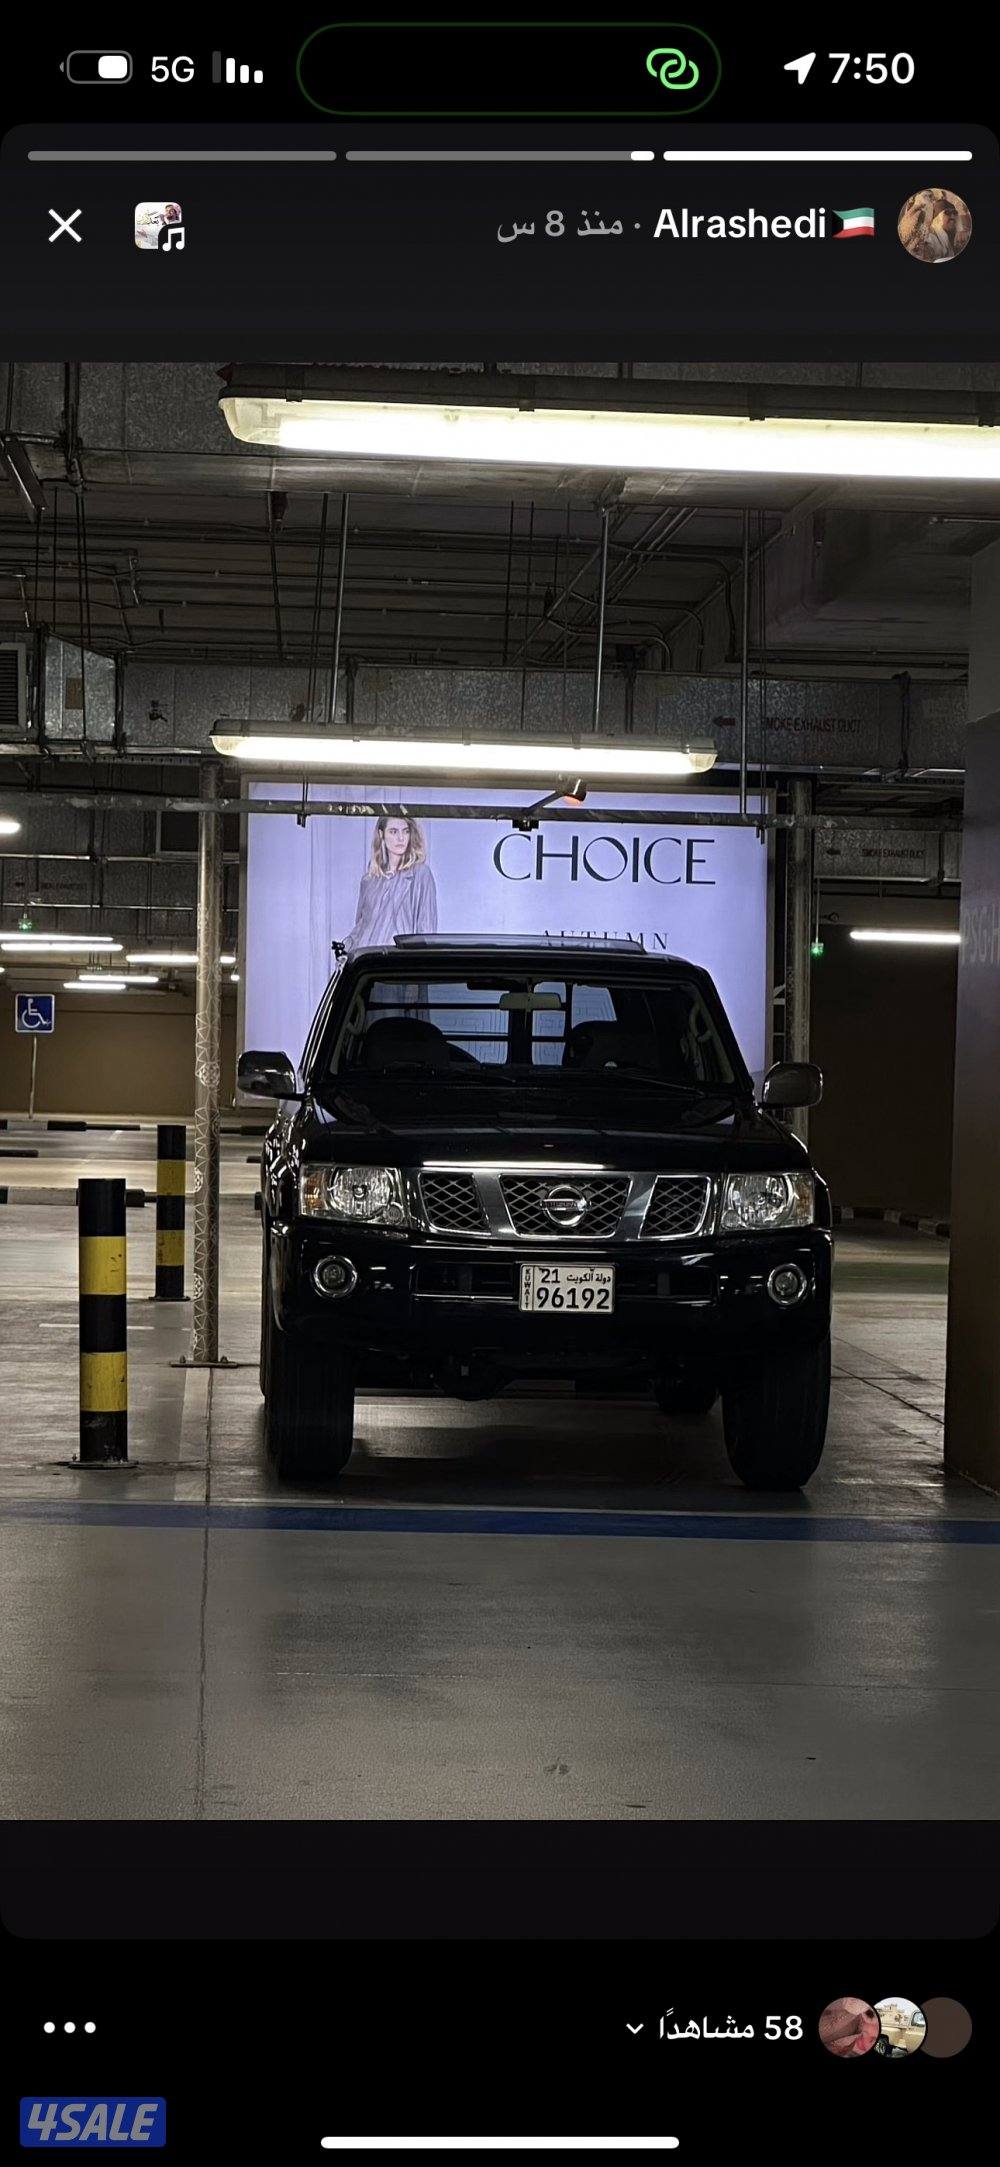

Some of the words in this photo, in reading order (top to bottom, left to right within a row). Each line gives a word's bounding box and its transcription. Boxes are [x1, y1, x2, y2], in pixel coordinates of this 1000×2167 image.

[493, 833, 716, 885] CHOICE
[540, 1269, 560, 1283] 21
[566, 1272, 594, 1284] الكويت
[595, 1273, 611, 1285] دولة
[536, 1287, 610, 1309] 96192
